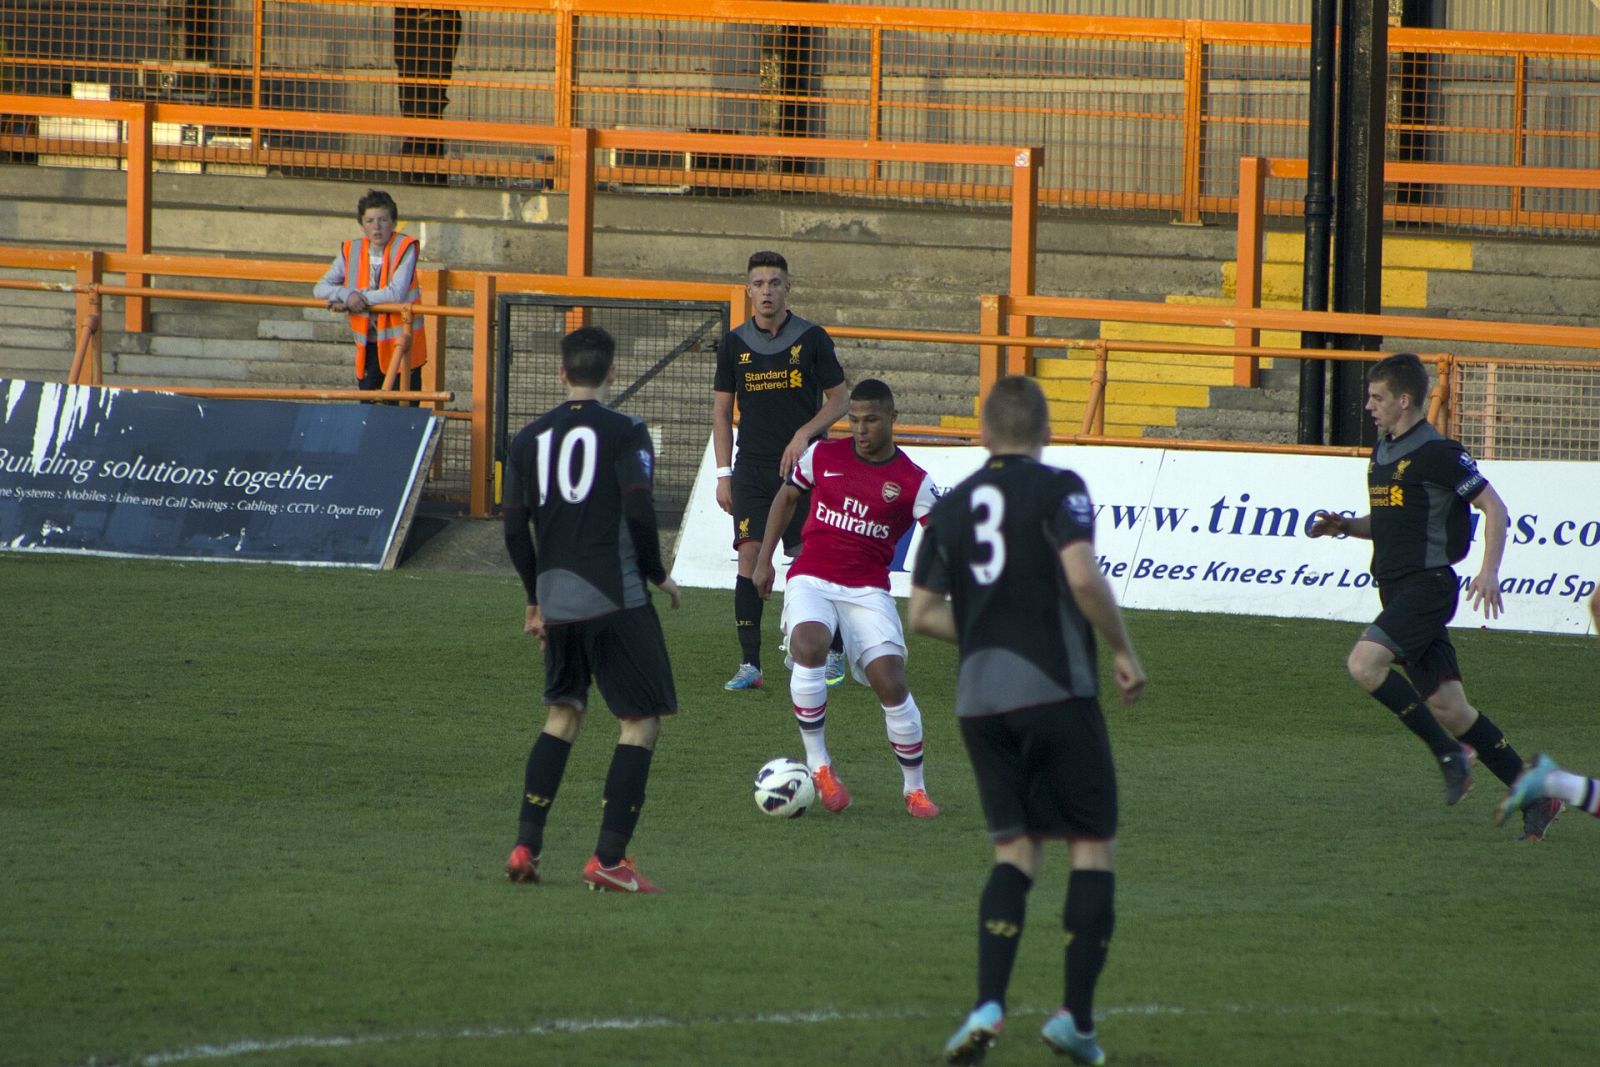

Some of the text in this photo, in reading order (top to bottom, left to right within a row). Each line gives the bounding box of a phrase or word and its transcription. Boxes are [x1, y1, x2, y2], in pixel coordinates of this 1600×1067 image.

[744, 370, 788, 382] Standard
[744, 380, 788, 392] Chartered
[99, 455, 218, 486] solutions
[224, 465, 333, 495] together
[535, 426, 598, 507] 10
[14, 486, 56, 503] Systems
[64, 489, 107, 502] Mobiles
[116, 492, 140, 505] Line
[141, 495, 162, 507] and
[165, 497, 187, 509] Call
[189, 498, 228, 513] Savings
[237, 500, 278, 515] Cabling
[287, 502, 319, 514] CCTV
[327, 504, 353, 516] Door
[356, 505, 384, 519] Entry
[815, 501, 890, 539] Emirates
[843, 496, 869, 519] Fly
[969, 485, 1006, 586] 3
[1094, 555, 1128, 579] he
[1133, 558, 1197, 581] Bees
[1202, 561, 1286, 584] Knees
[1291, 564, 1334, 587] for
[1500, 573, 1557, 595] and
